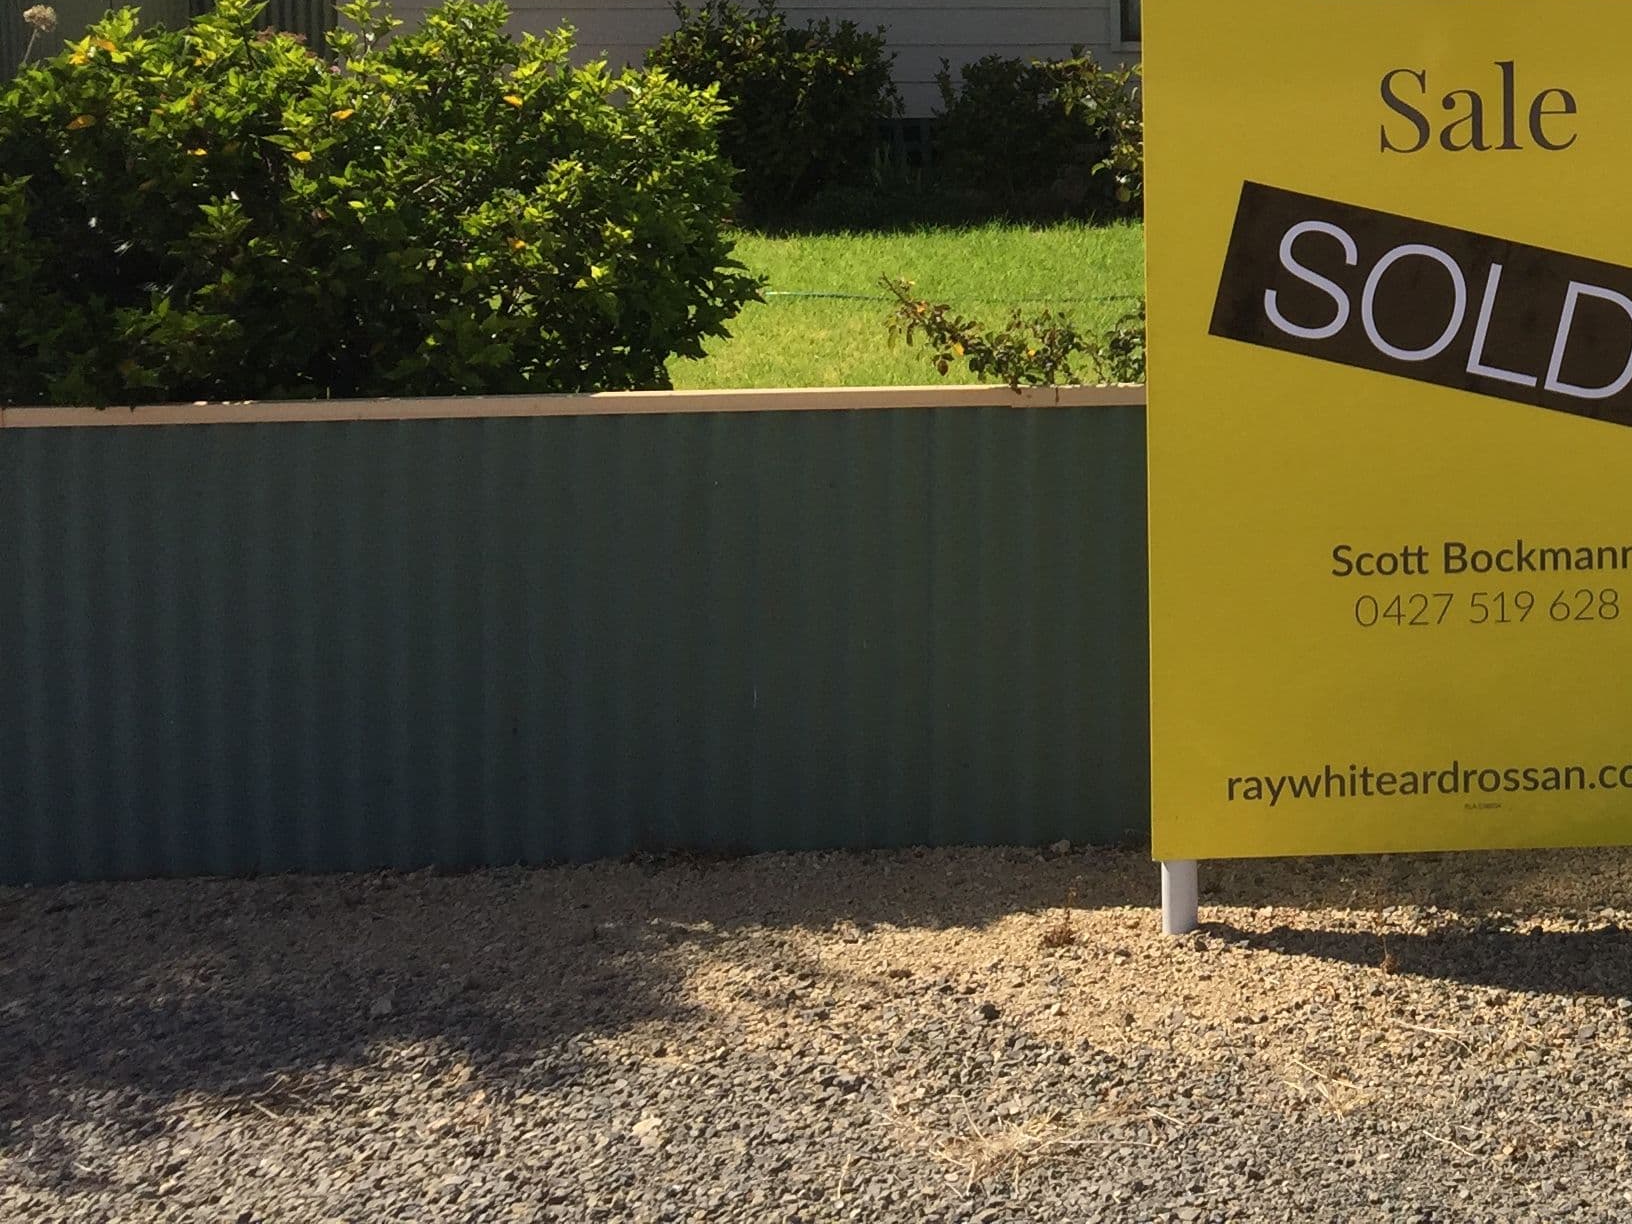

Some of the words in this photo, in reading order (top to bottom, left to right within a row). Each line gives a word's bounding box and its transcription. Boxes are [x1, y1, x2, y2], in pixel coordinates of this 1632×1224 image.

[1378, 60, 1578, 153] Sale
[1331, 543, 1429, 578] Scott
[1355, 592, 1455, 628] 0427
[1468, 590, 1536, 625] 519
[1548, 588, 1621, 623] 628
